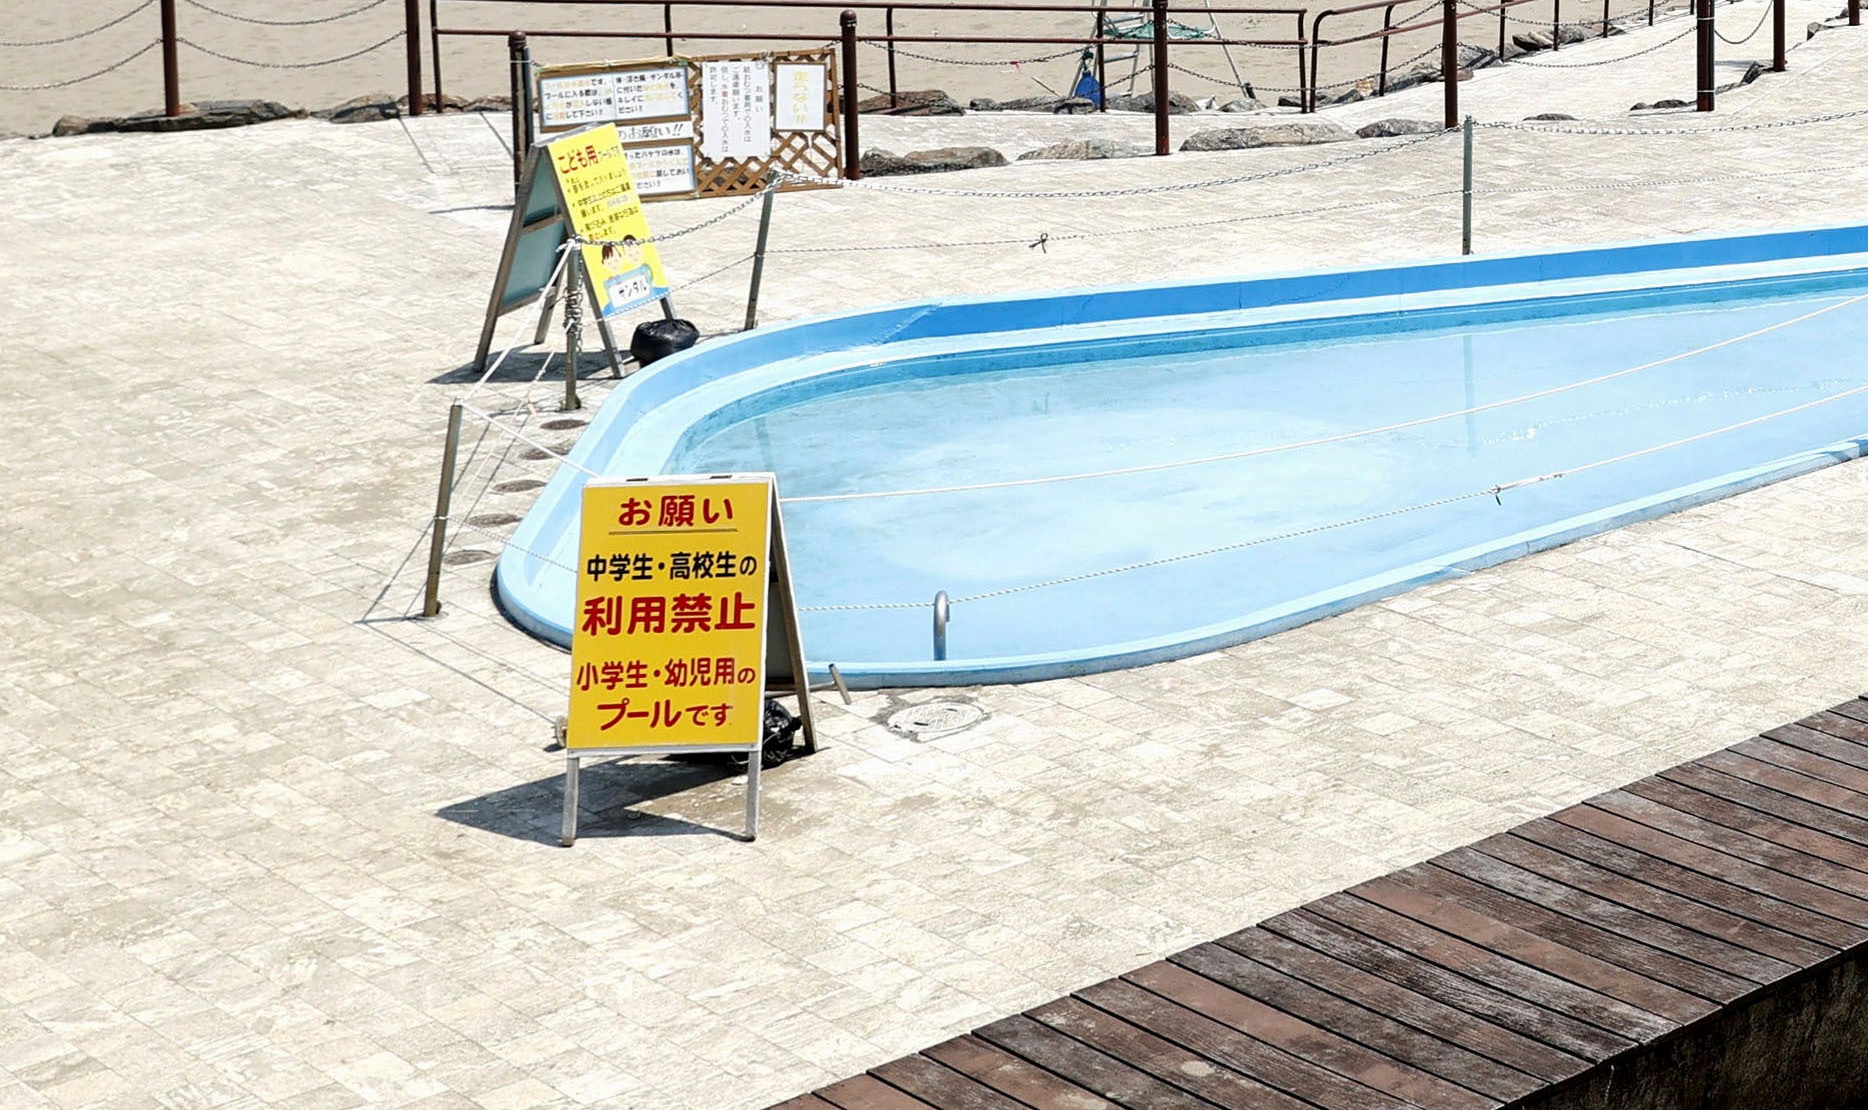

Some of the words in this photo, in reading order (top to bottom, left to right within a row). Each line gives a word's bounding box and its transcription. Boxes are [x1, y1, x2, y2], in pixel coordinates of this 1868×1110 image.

[618, 494, 734, 528] お願い
[586, 550, 758, 582] 中学生・高校生の
[581, 591, 757, 636] 利用禁止
[576, 656, 757, 691] 小学生・幼児用の
[596, 698, 734, 731] プールです
